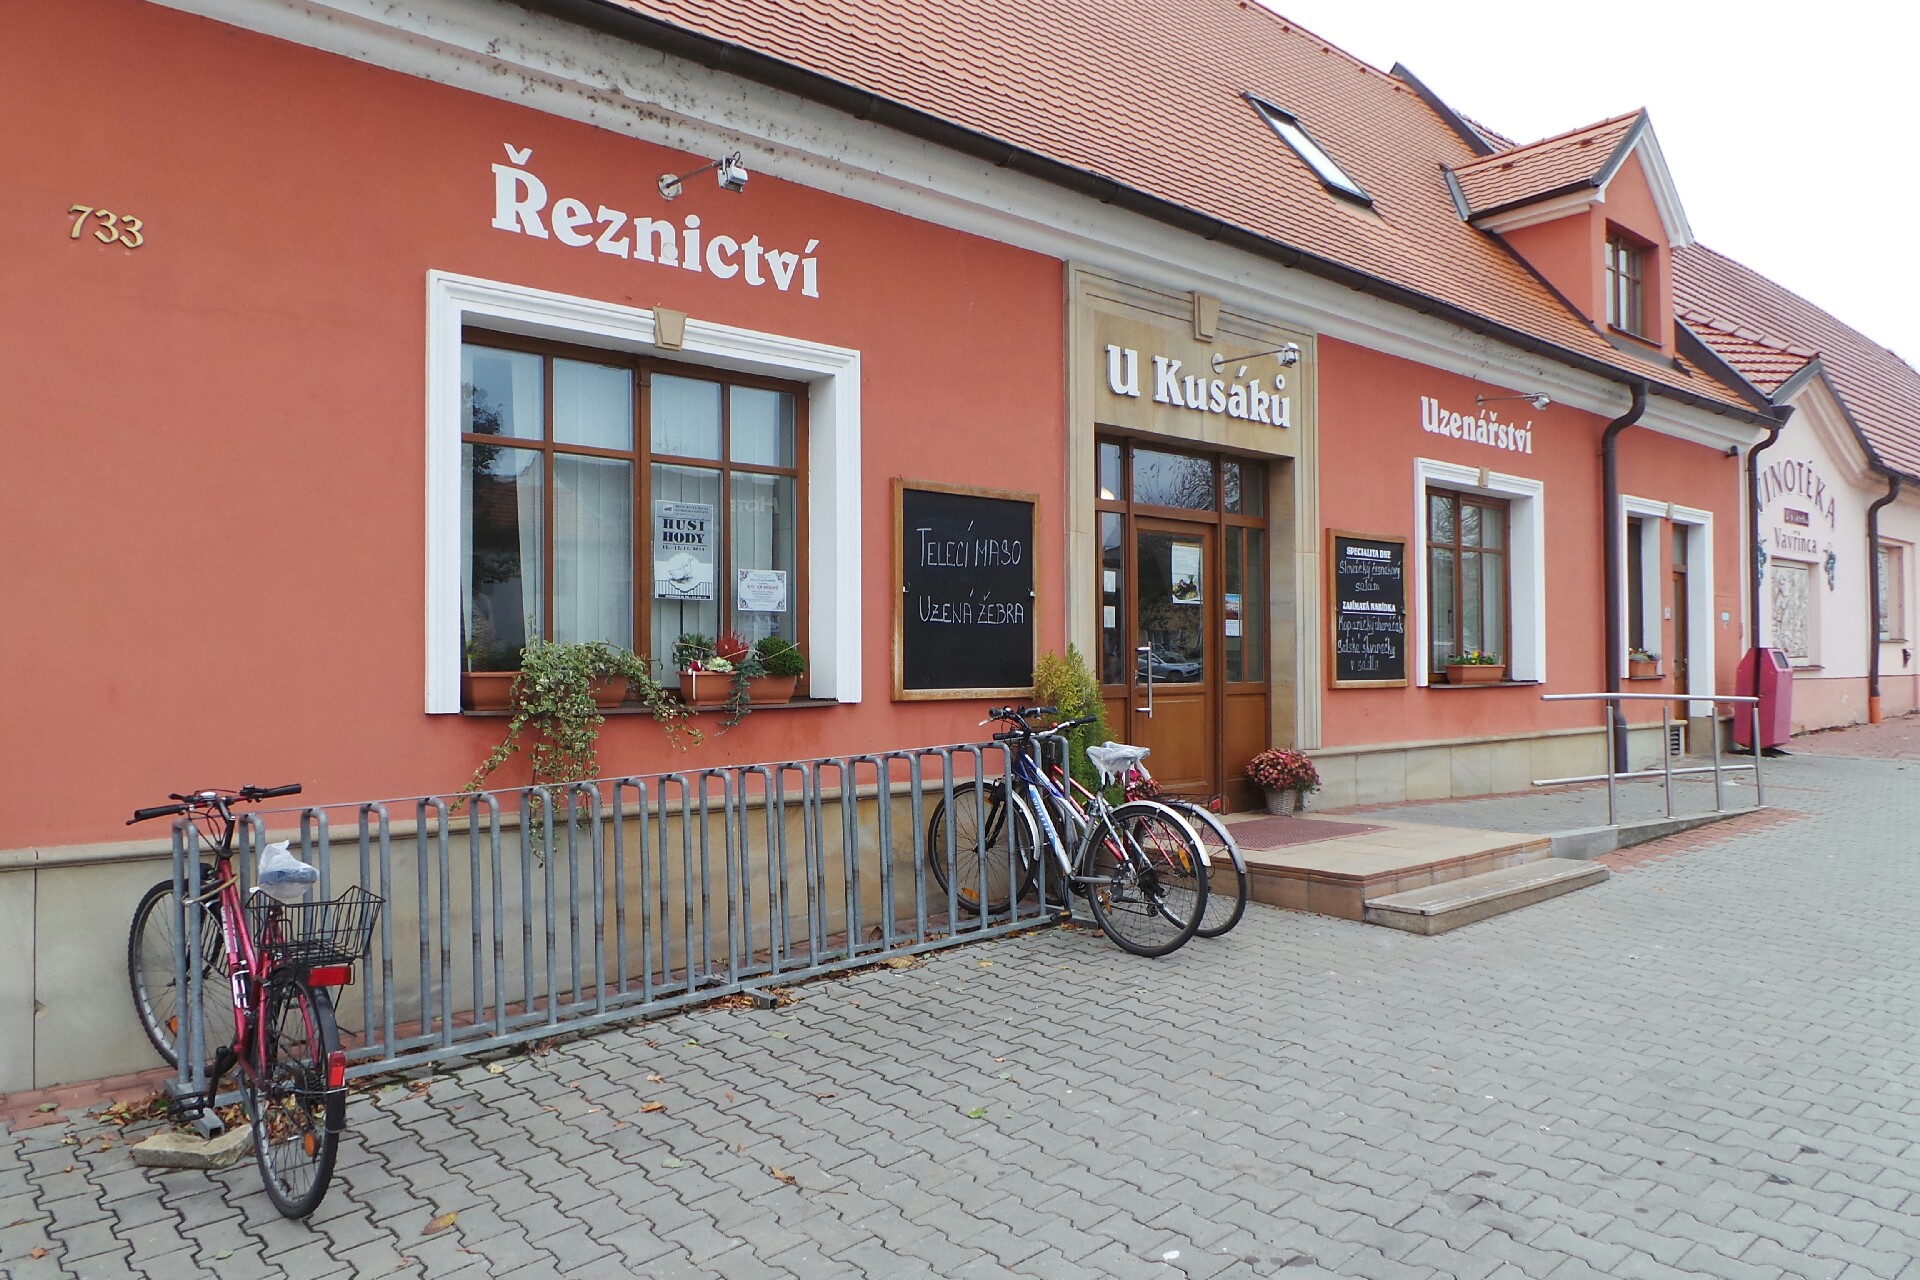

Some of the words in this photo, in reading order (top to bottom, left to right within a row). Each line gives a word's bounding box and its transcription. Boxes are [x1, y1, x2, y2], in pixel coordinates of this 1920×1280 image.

[68, 204, 144, 249] 733
[491, 142, 820, 299] Řeznictví
[1105, 344, 1141, 397] U
[1420, 395, 1533, 454] Uzenářství
[662, 517, 705, 532] HUSÍ
[662, 531, 705, 544] HODY
[974, 539, 1022, 567] MASO
[976, 591, 1025, 625] ŽEBRA
